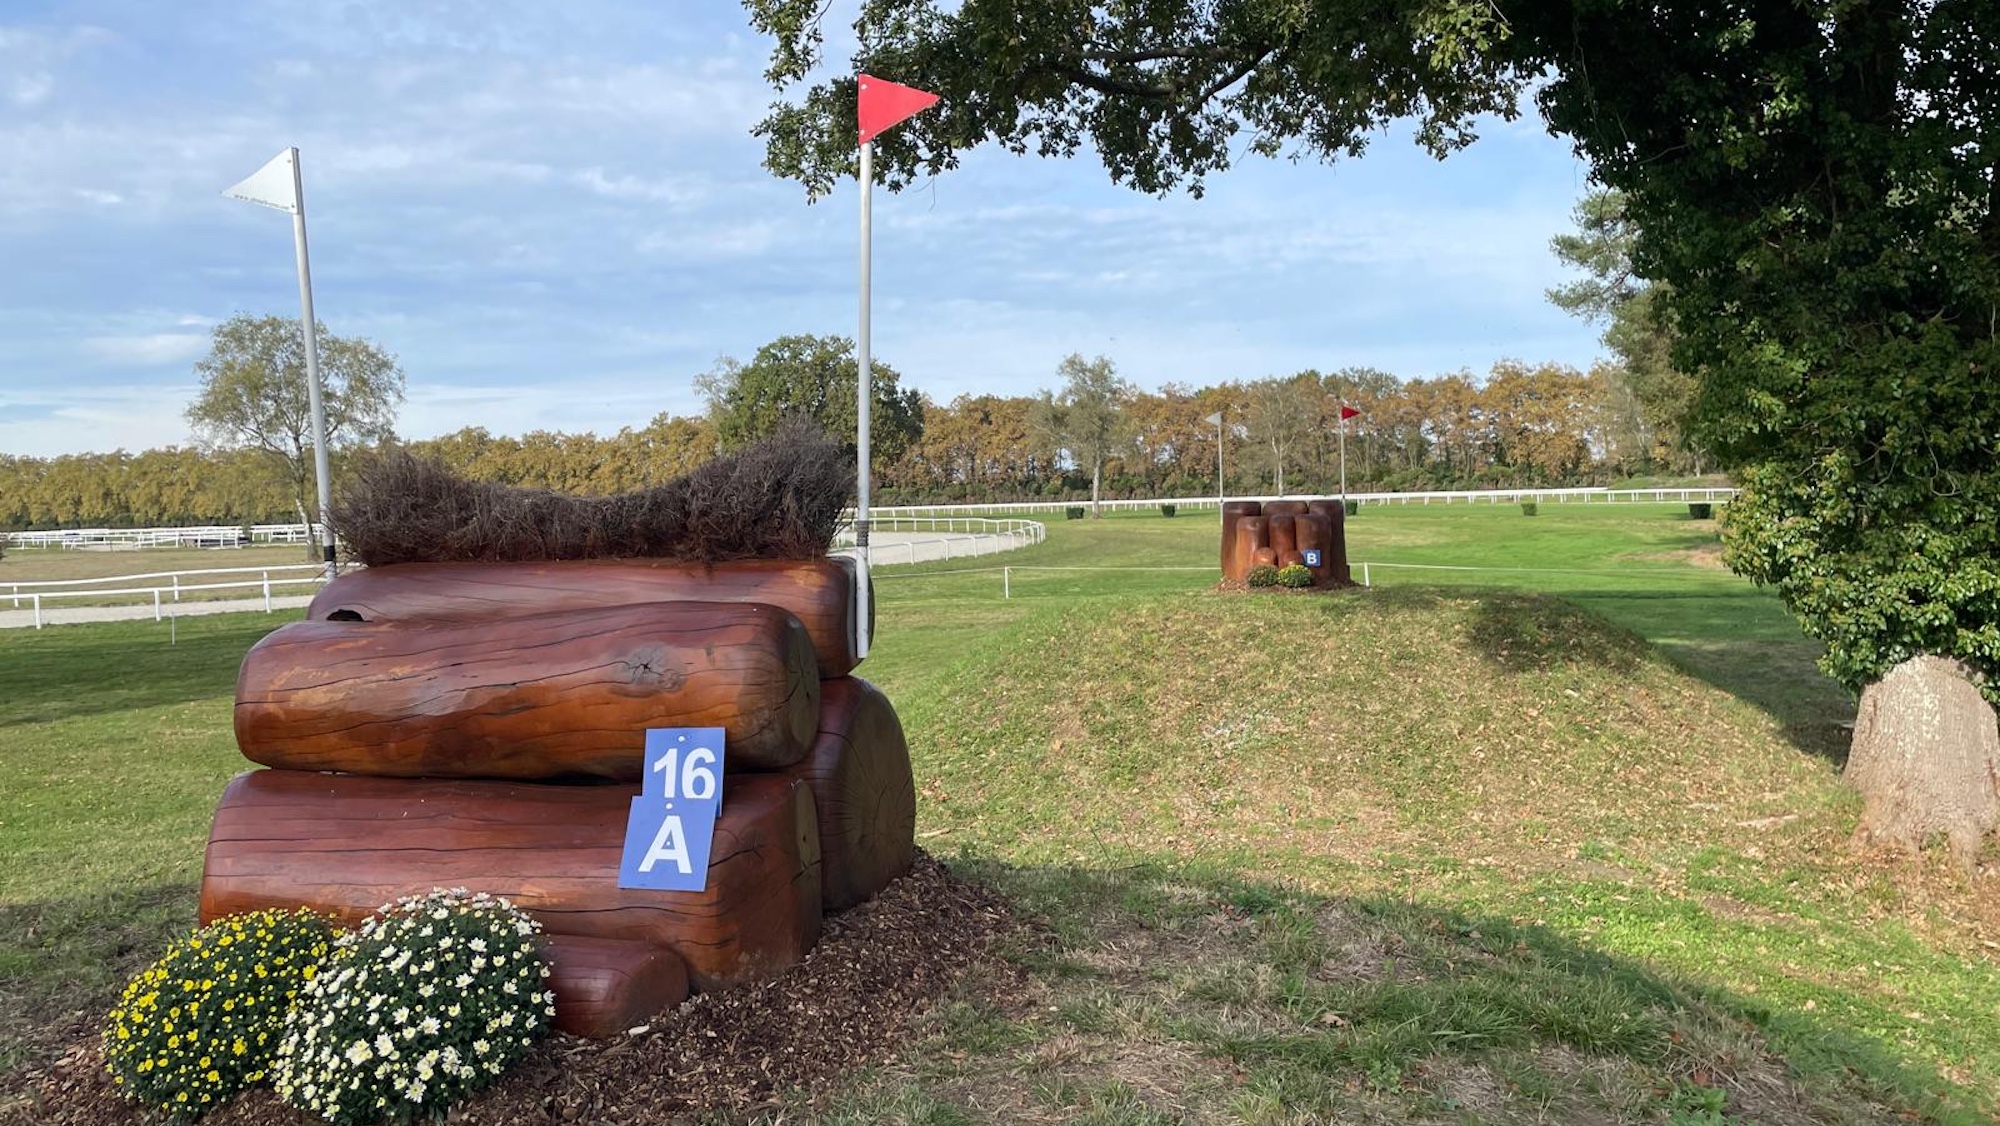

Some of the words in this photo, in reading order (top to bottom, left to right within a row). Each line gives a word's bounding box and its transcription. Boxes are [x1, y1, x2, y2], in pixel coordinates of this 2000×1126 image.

[1307, 553, 1317, 564] B
[653, 747, 716, 799] 16
[638, 815, 692, 874] A
